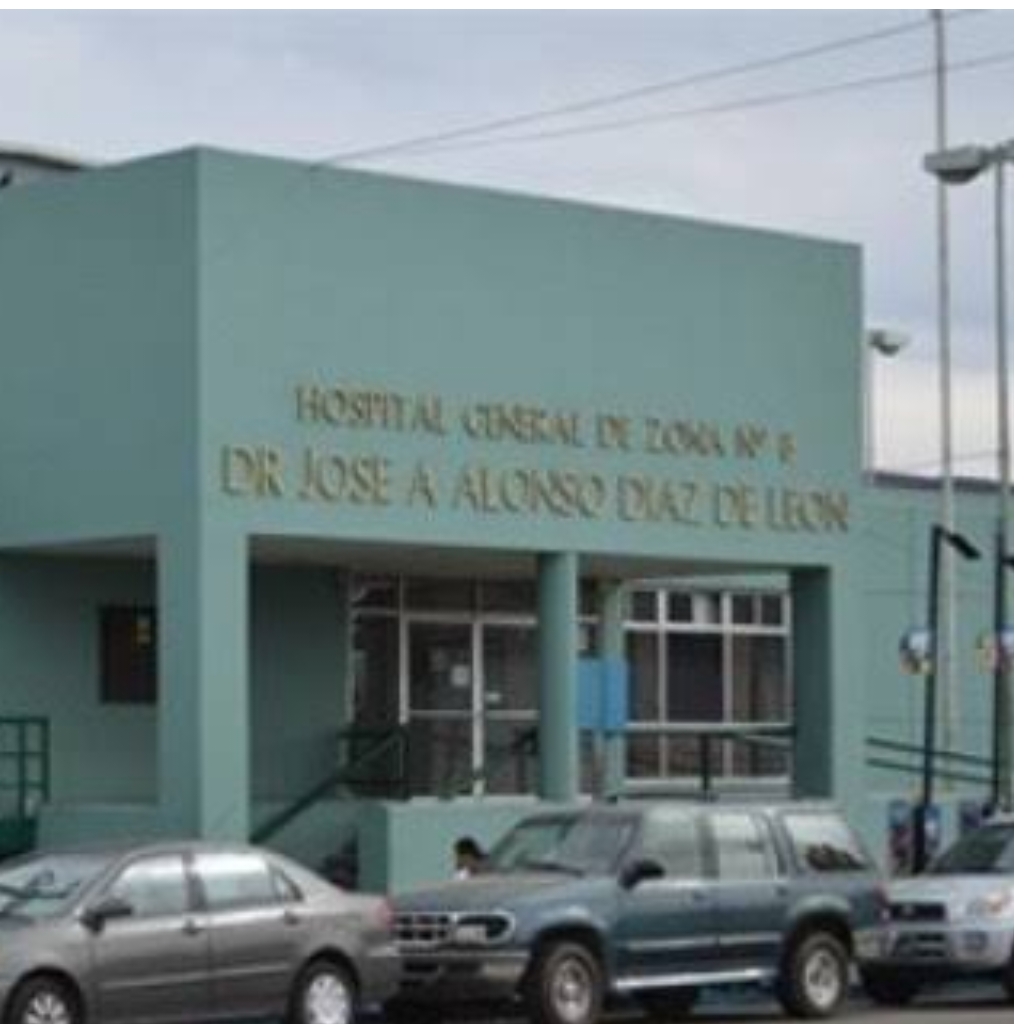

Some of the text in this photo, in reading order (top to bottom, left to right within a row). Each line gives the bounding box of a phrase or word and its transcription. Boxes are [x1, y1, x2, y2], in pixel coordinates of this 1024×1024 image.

[293, 384, 446, 436] HOSPITAL
[459, 401, 583, 449] GENERAL
[596, 413, 632, 452] DE
[643, 416, 726, 458] ZONA
[220, 444, 850, 534] DR JOSE A ALONSO DIAZ DE LEON
